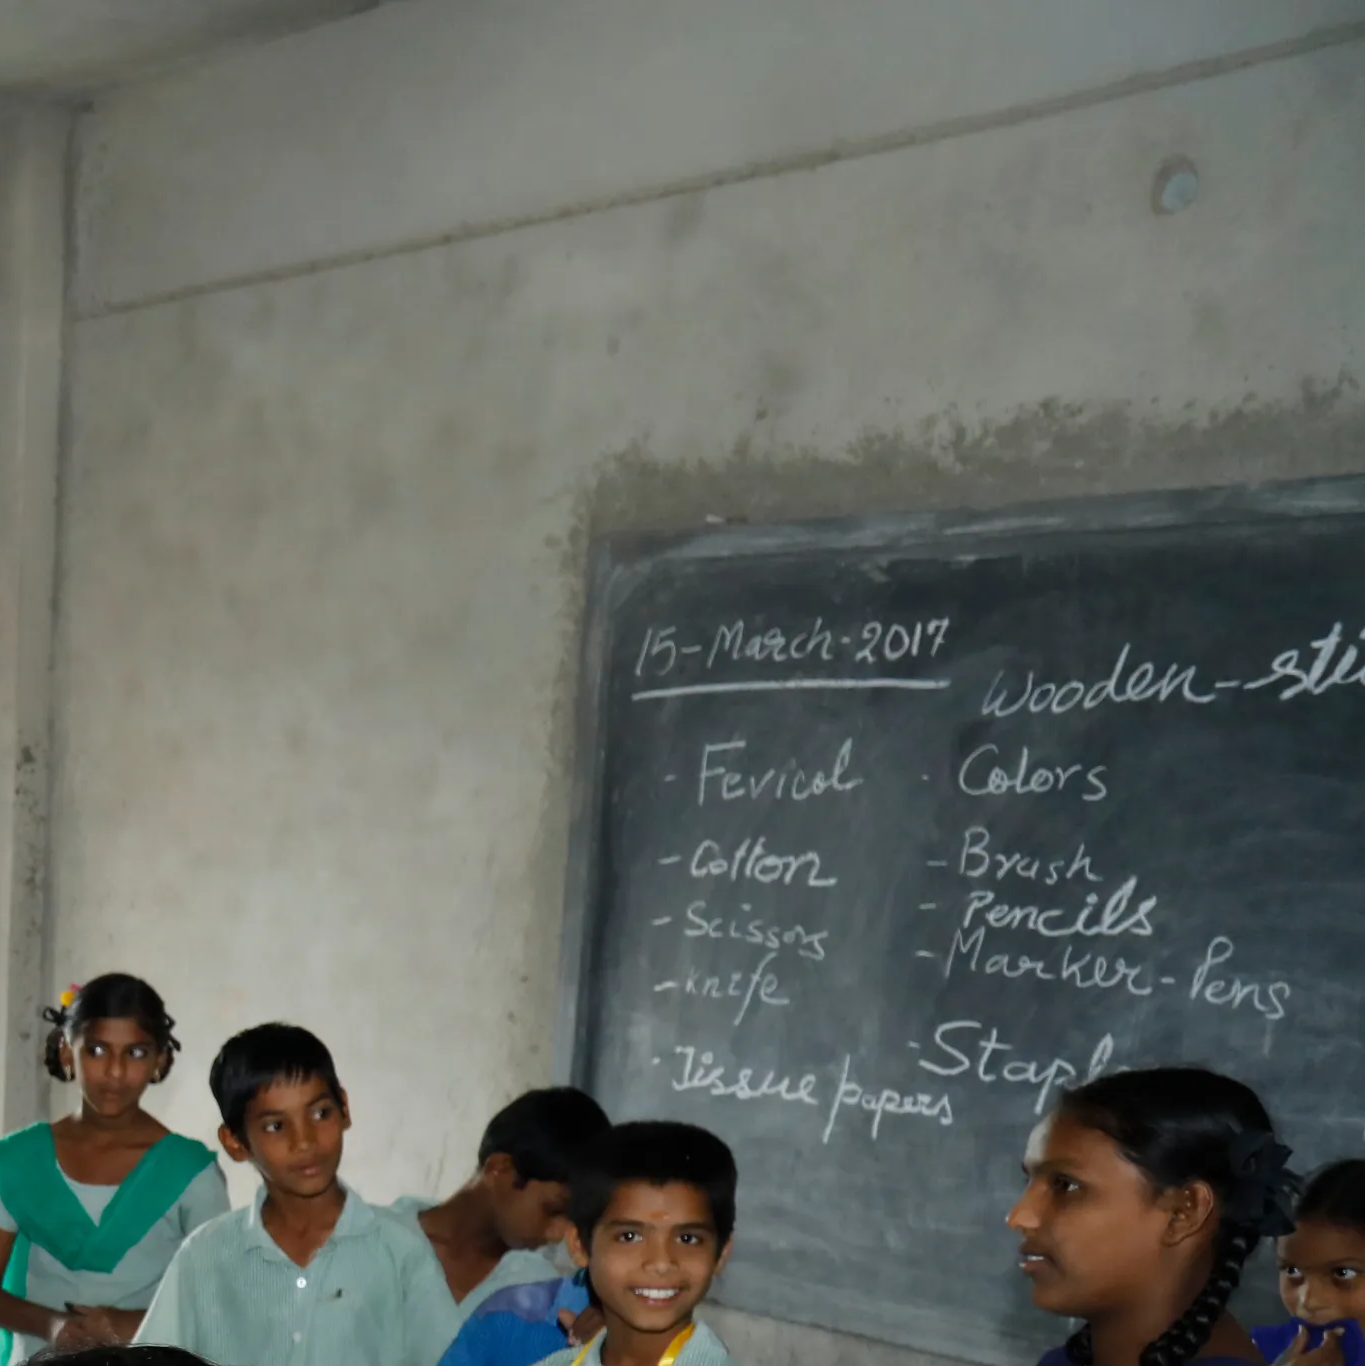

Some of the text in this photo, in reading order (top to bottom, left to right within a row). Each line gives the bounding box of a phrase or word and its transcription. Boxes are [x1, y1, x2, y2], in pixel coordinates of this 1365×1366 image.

[697, 737, 865, 807] Fevicol
[959, 743, 1108, 801] Colors
[959, 826, 1103, 885] Brush
[962, 875, 1158, 937] Pencils
[672, 1046, 953, 1143] Tissue papers
[918, 1020, 1131, 1115] Stapl
